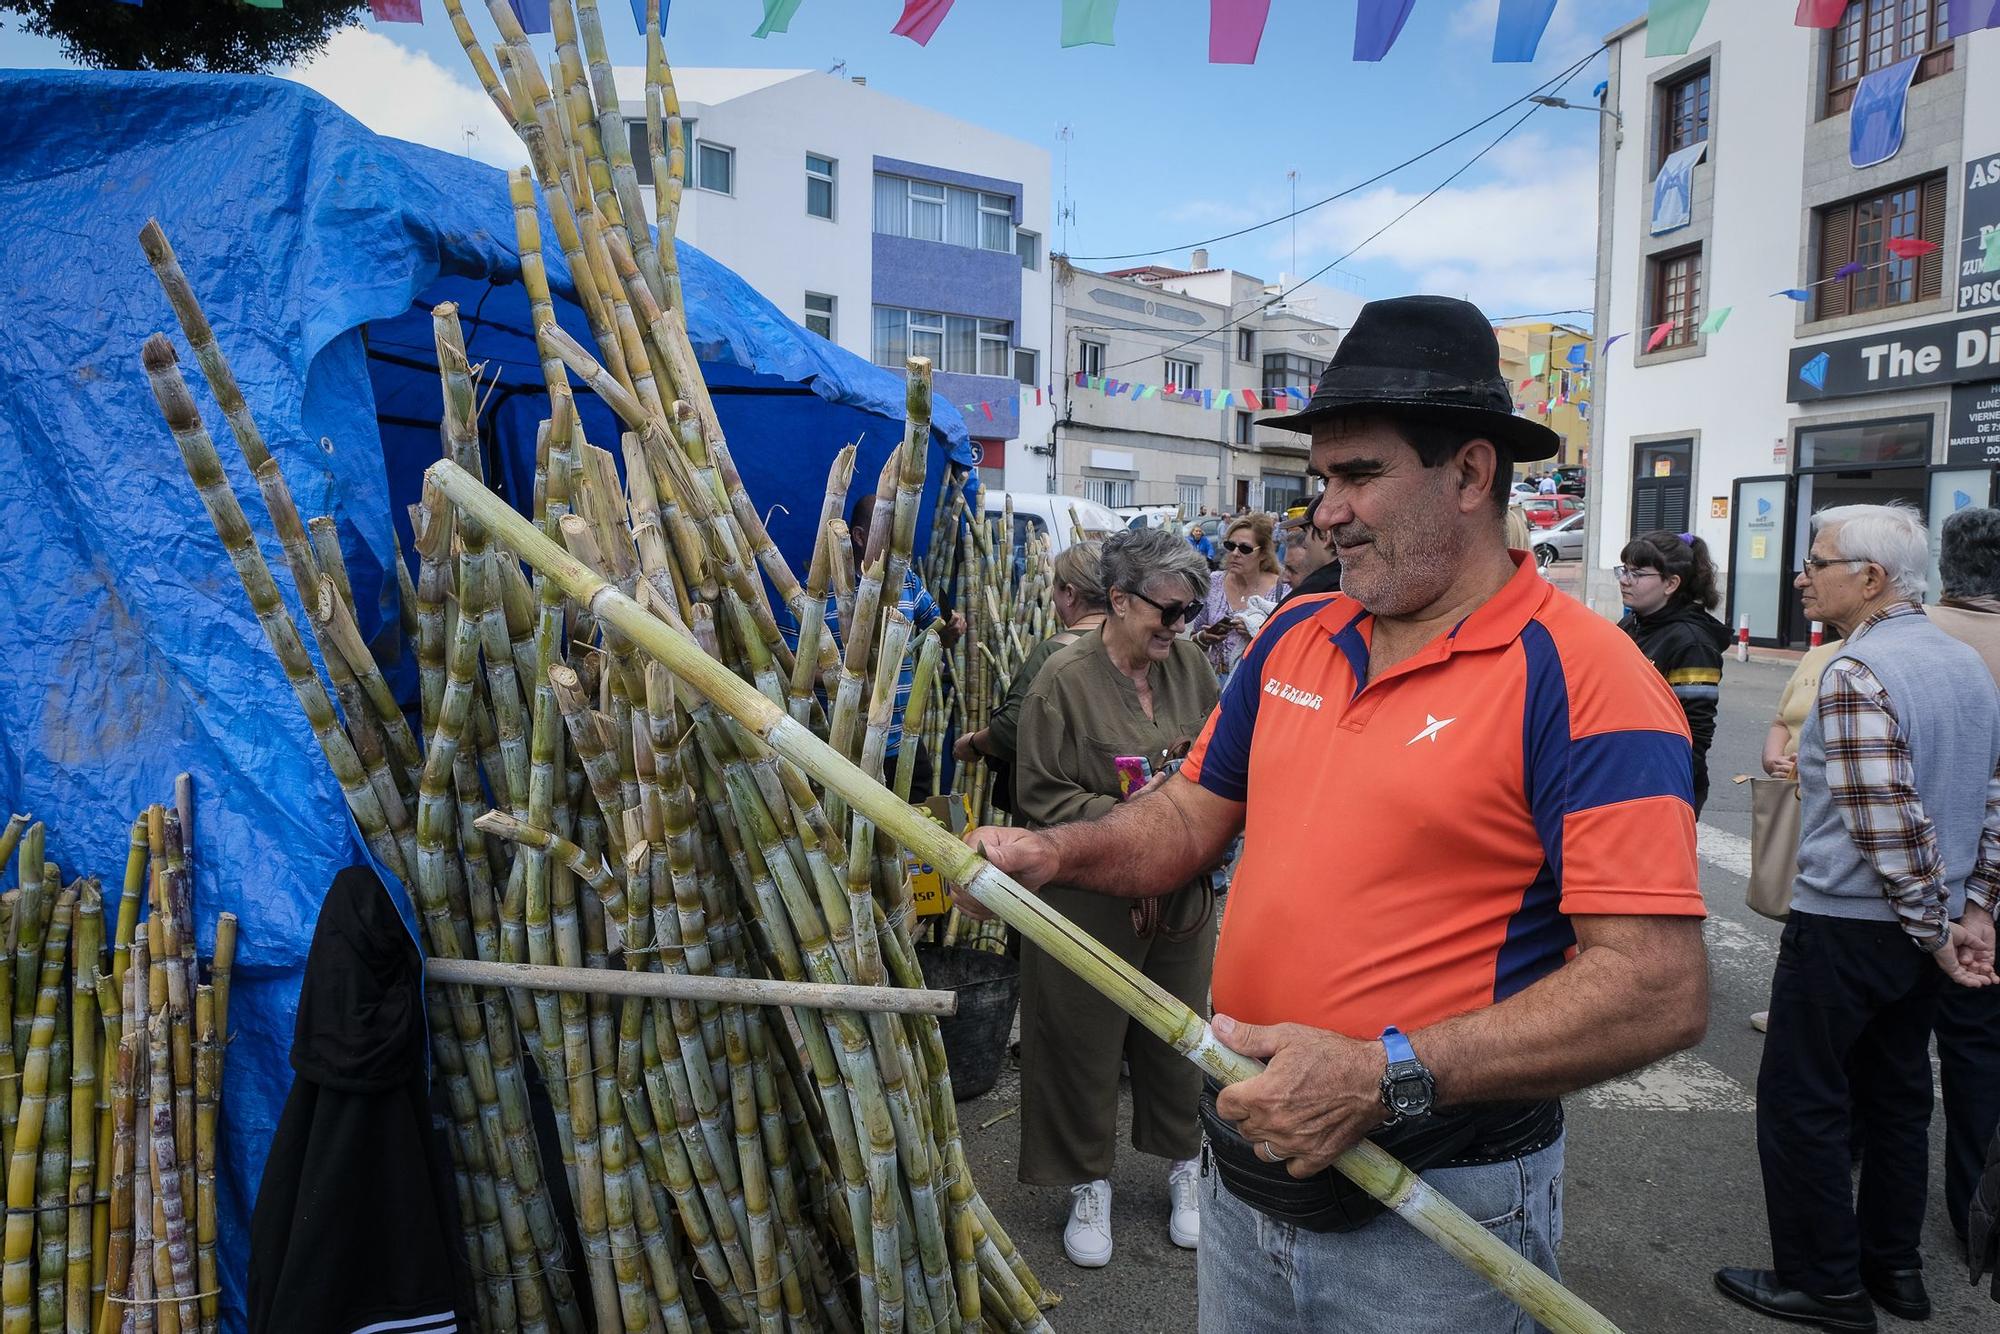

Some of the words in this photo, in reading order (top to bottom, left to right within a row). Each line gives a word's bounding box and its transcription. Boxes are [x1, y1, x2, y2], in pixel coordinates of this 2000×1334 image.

[1861, 342, 1941, 381] The
[1956, 326, 2000, 369] Di
[1978, 424, 1990, 432] DE
[1950, 437, 1980, 445] MARTES
[1980, 435, 1986, 443] Y
